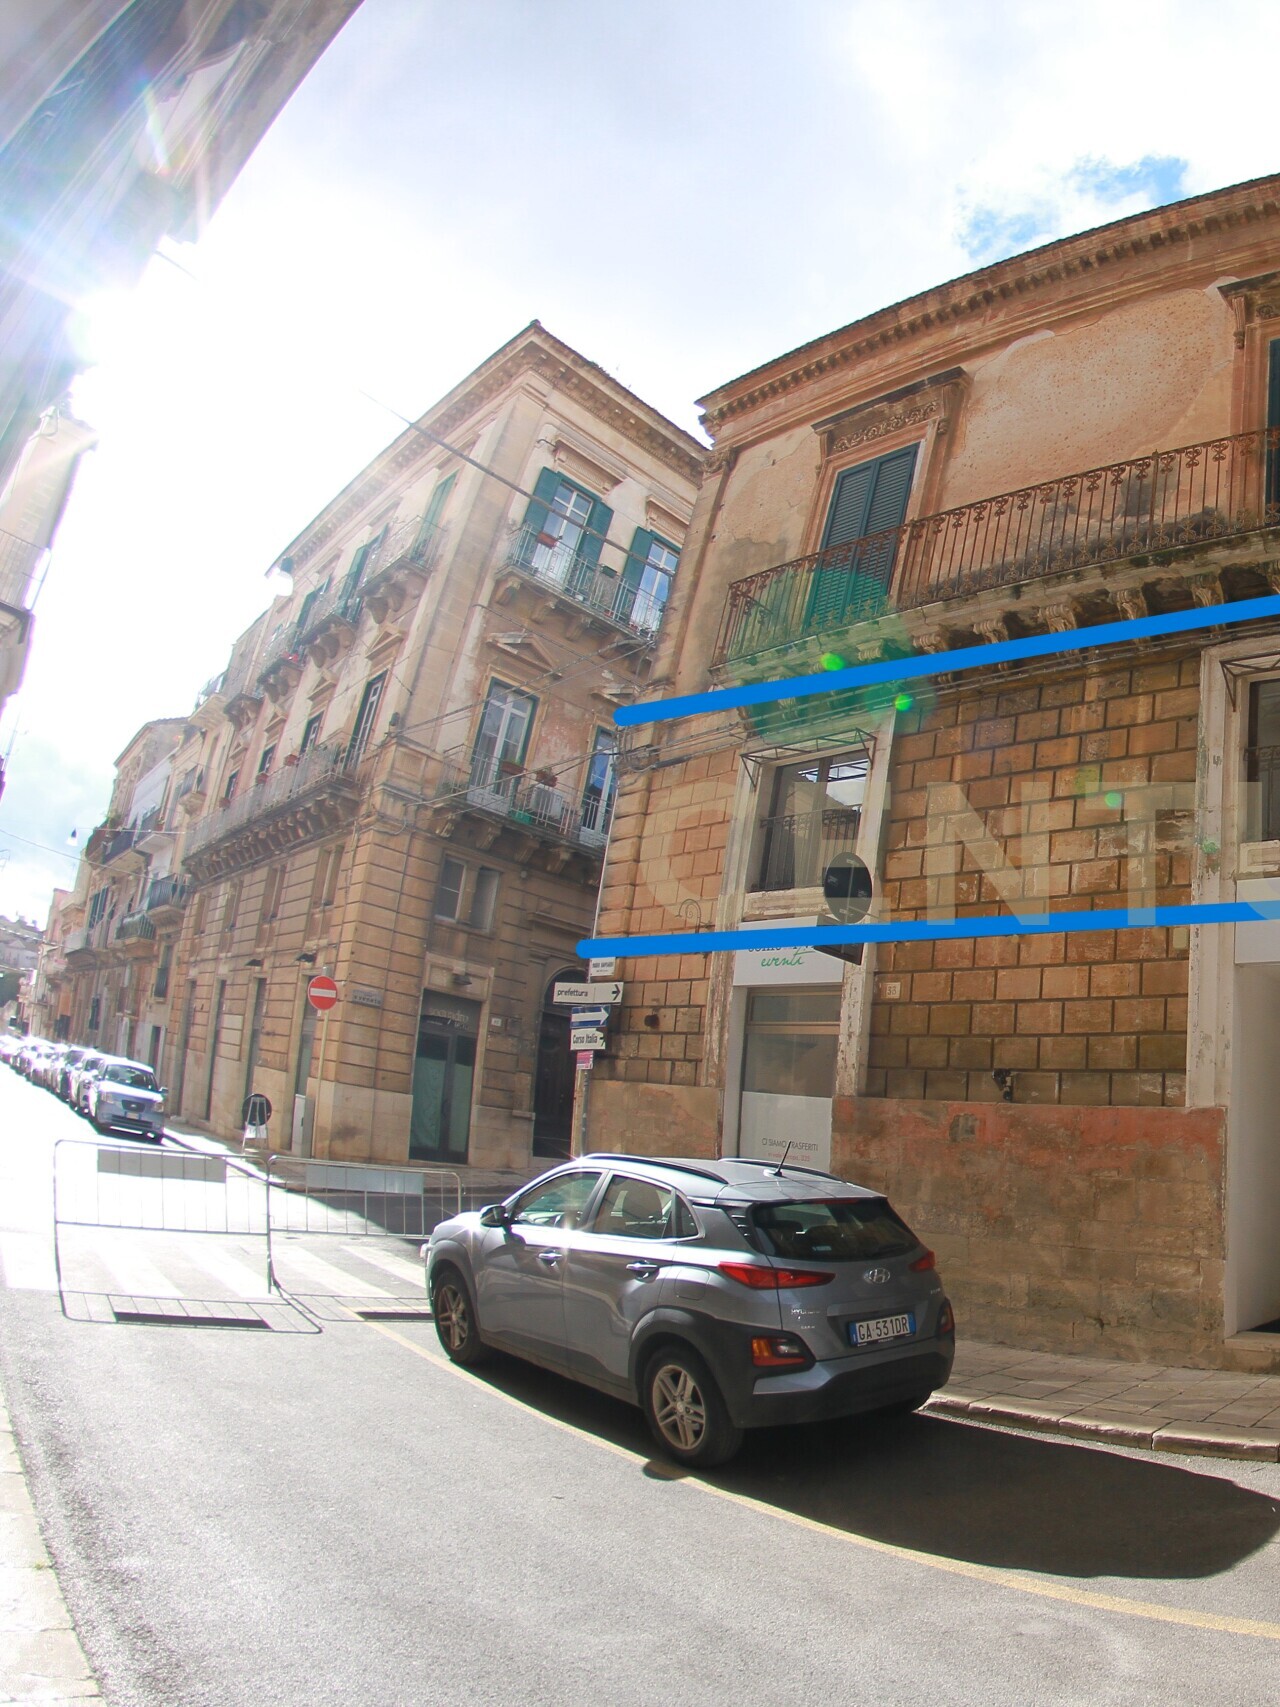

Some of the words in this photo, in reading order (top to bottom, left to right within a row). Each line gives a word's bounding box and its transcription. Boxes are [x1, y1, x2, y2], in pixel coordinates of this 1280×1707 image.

[761, 947, 815, 967] eventi
[557, 987, 589, 997] prefettura
[572, 1034, 585, 1044] Corso
[585, 1034, 598, 1044] Italia
[787, 1140, 819, 1152] RASFERITI
